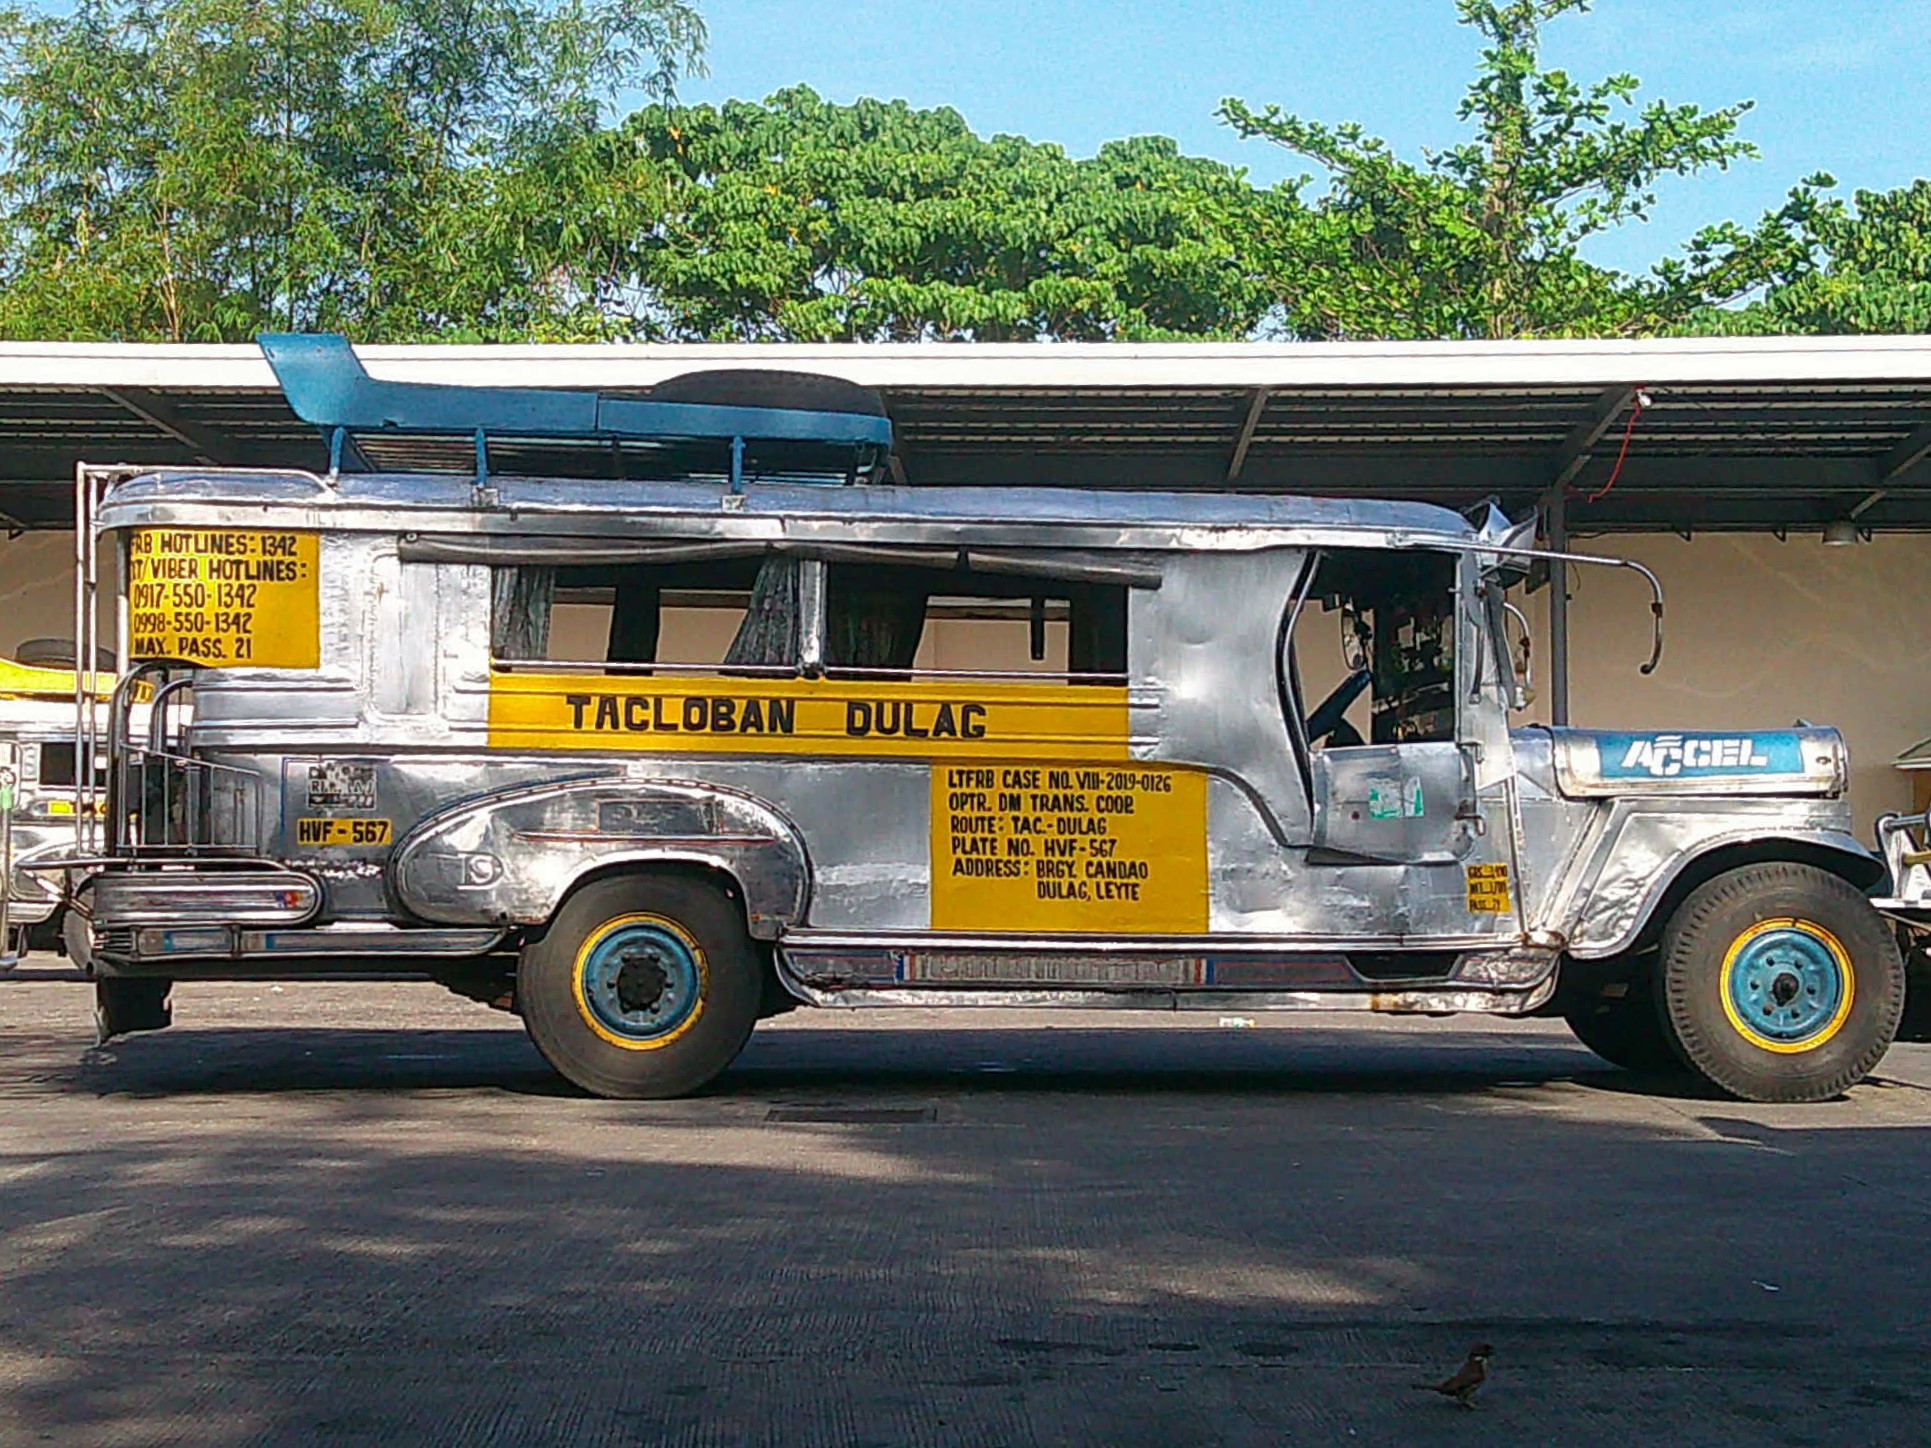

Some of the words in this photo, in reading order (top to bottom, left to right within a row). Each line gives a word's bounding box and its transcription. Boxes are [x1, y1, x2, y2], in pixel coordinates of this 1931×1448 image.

[160, 533, 256, 555] HOTLINES:
[261, 536, 297, 556] 1342
[209, 559, 307, 581] HOTLINES:
[134, 583, 256, 608] 0917-550-1342
[134, 612, 252, 634] 0998-550-1342
[134, 637, 171, 655] MAX.
[178, 637, 227, 658] PASS.
[235, 637, 251, 658] 21
[566, 695, 795, 734] TACLOBAN
[846, 701, 987, 738] DULAG
[948, 769, 995, 789] LTFRB
[1002, 770, 1041, 789] CASE
[948, 792, 992, 812] OPTR.
[999, 793, 1021, 812] DM
[1030, 794, 1089, 813] TRANS.
[951, 815, 1004, 834] ROUTE:
[951, 836, 997, 856] PLATE
[1007, 838, 1036, 856] NO.
[952, 858, 1030, 878] ADDRESS:
[1085, 861, 1149, 880] CANDAO
[1037, 882, 1092, 902] DULAG,
[1096, 882, 1141, 901] LEYTE
